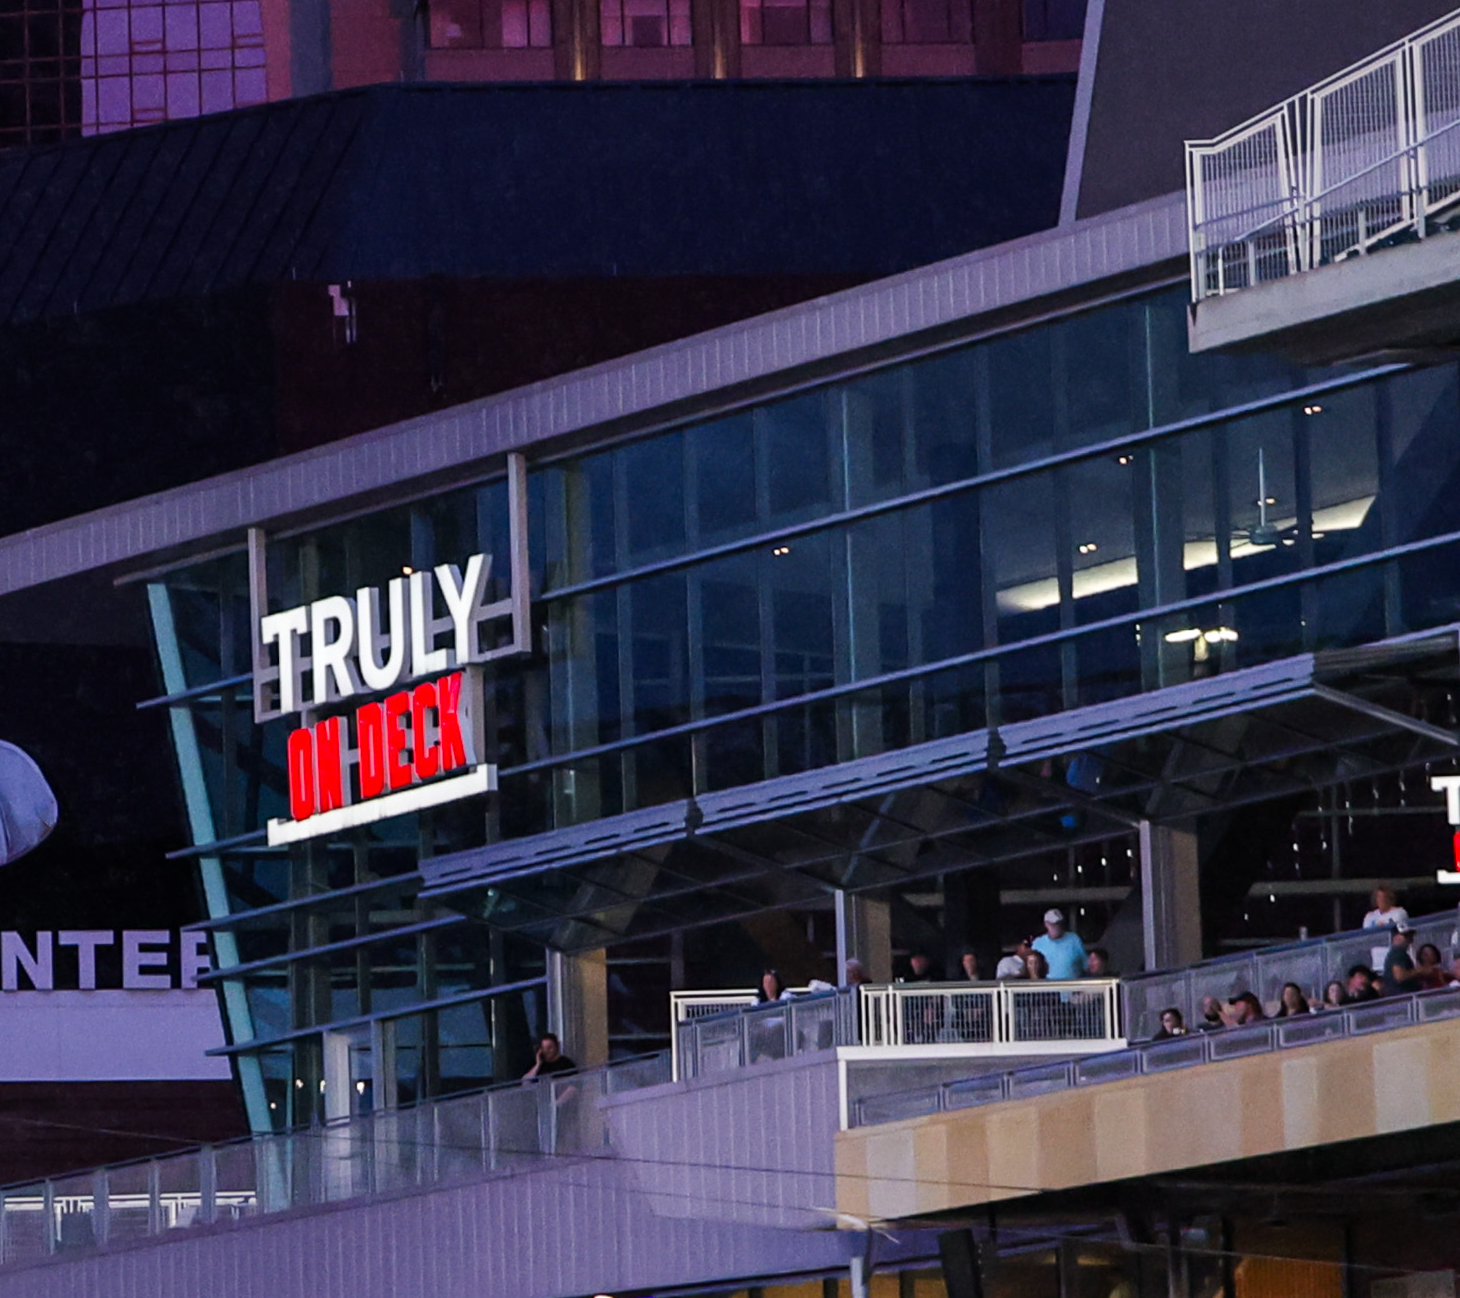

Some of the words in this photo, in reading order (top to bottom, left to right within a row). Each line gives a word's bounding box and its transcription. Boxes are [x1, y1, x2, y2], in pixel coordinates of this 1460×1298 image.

[261, 553, 492, 714] TRULY
[287, 716, 343, 821] ON
[356, 671, 467, 799] DECK
